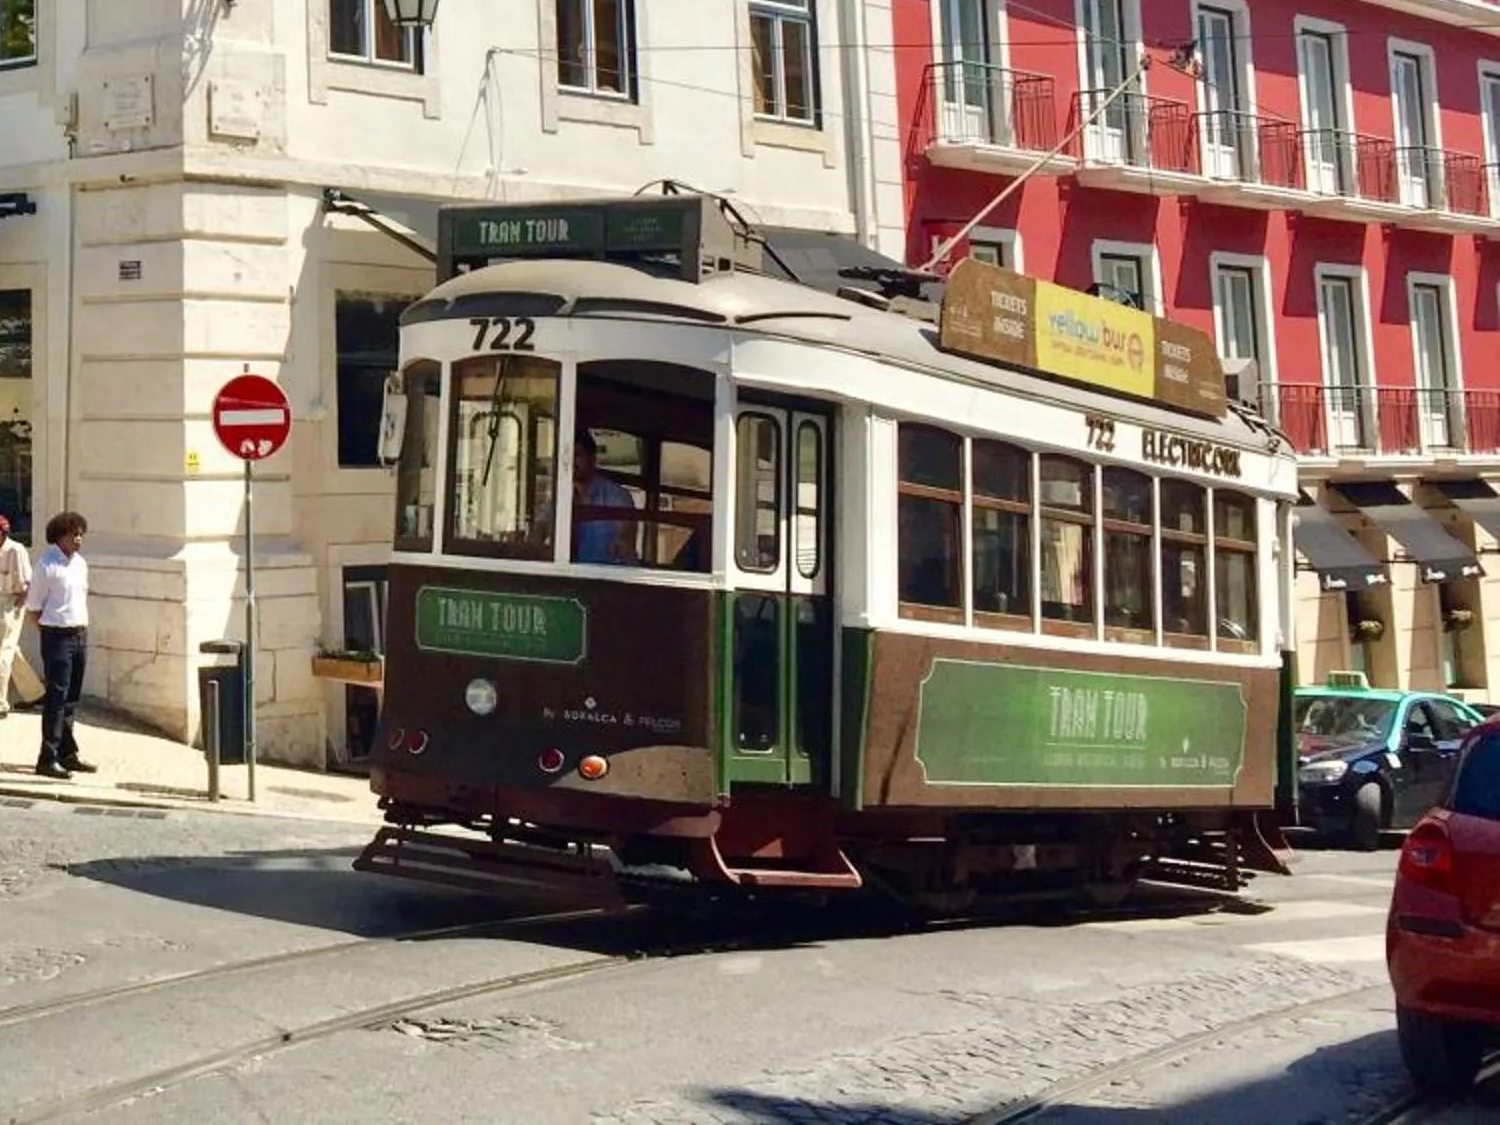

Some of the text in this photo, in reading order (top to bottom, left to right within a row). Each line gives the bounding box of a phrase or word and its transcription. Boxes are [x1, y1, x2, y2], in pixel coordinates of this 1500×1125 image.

[479, 219, 569, 244] TRAM TOUR
[991, 290, 1027, 316] TICKETS
[469, 317, 535, 351] 722
[1085, 412, 1116, 453] 722
[437, 596, 547, 637] TRAM TOUR
[1049, 686, 1148, 741] TRAM TOUR
